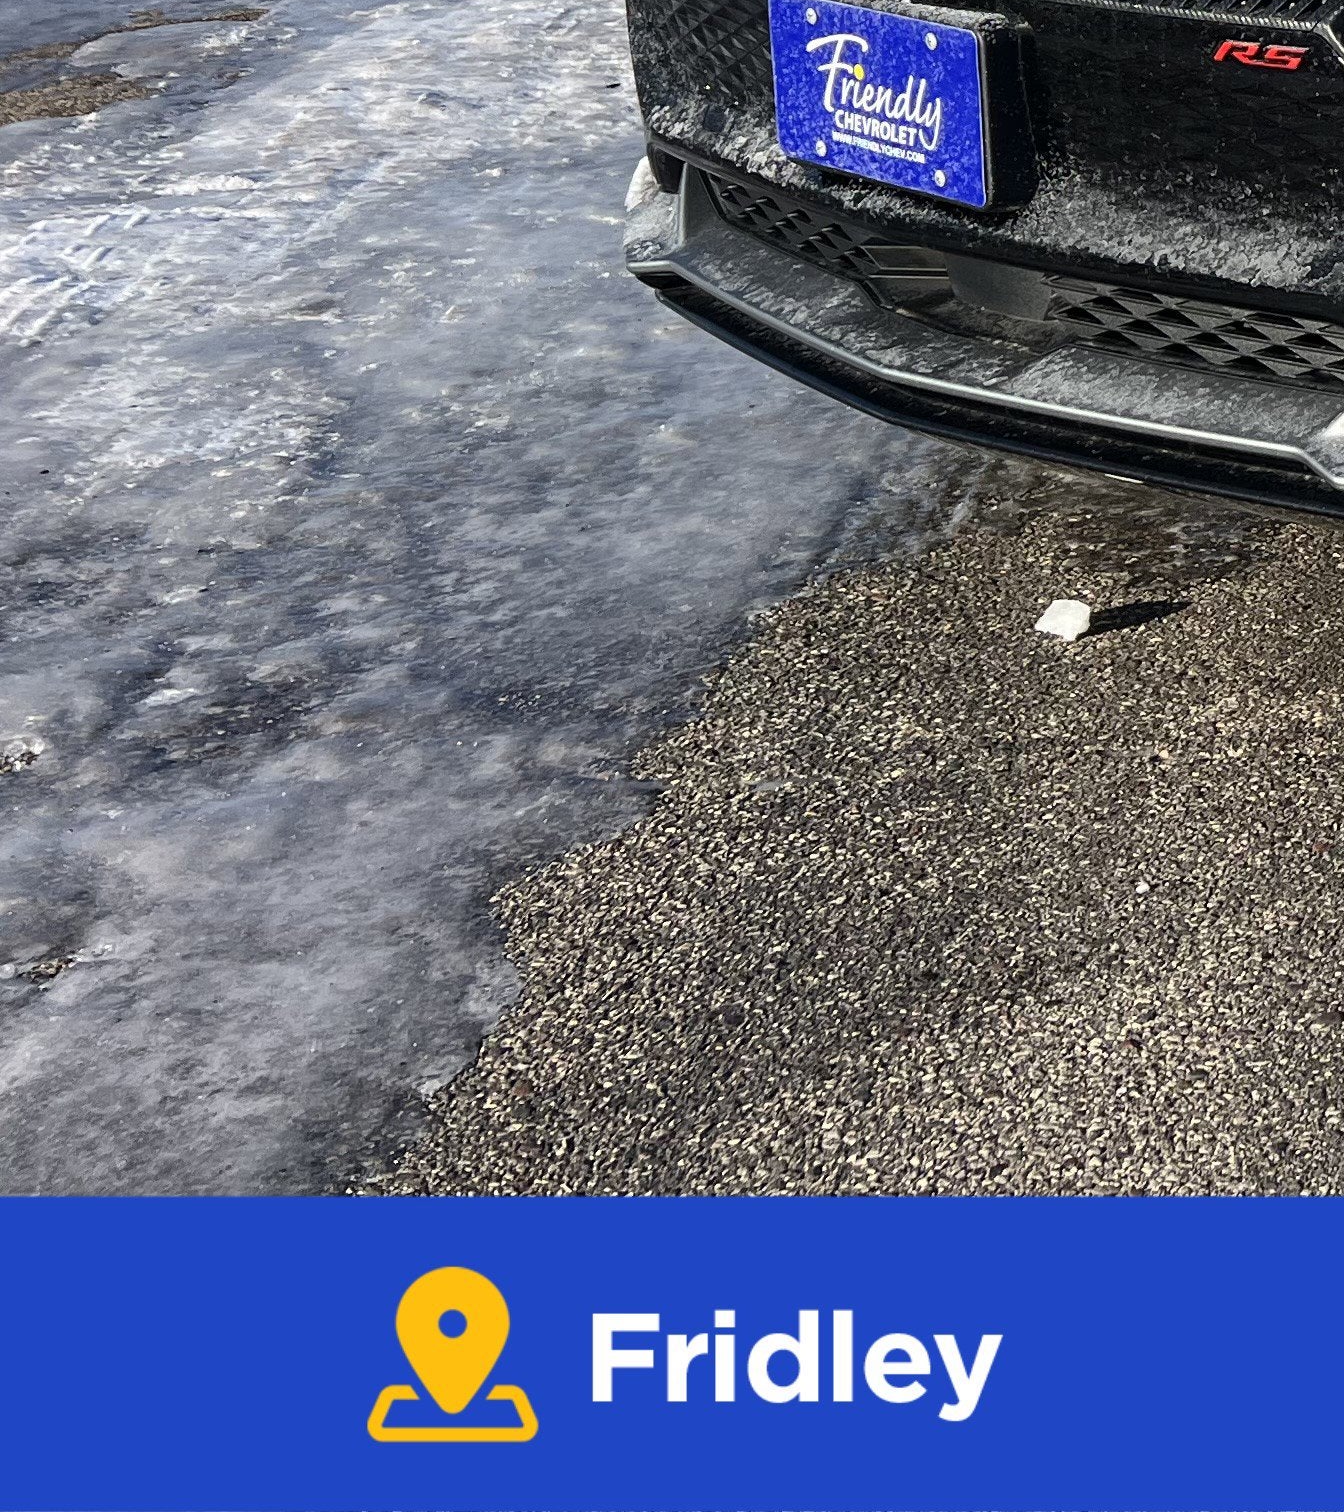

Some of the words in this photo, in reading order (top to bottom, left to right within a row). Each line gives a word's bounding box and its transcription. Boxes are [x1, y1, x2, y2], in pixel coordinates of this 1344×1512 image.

[1213, 39, 1310, 70] RS
[805, 33, 943, 151] Friendly
[834, 109, 918, 146] CHEVROLET
